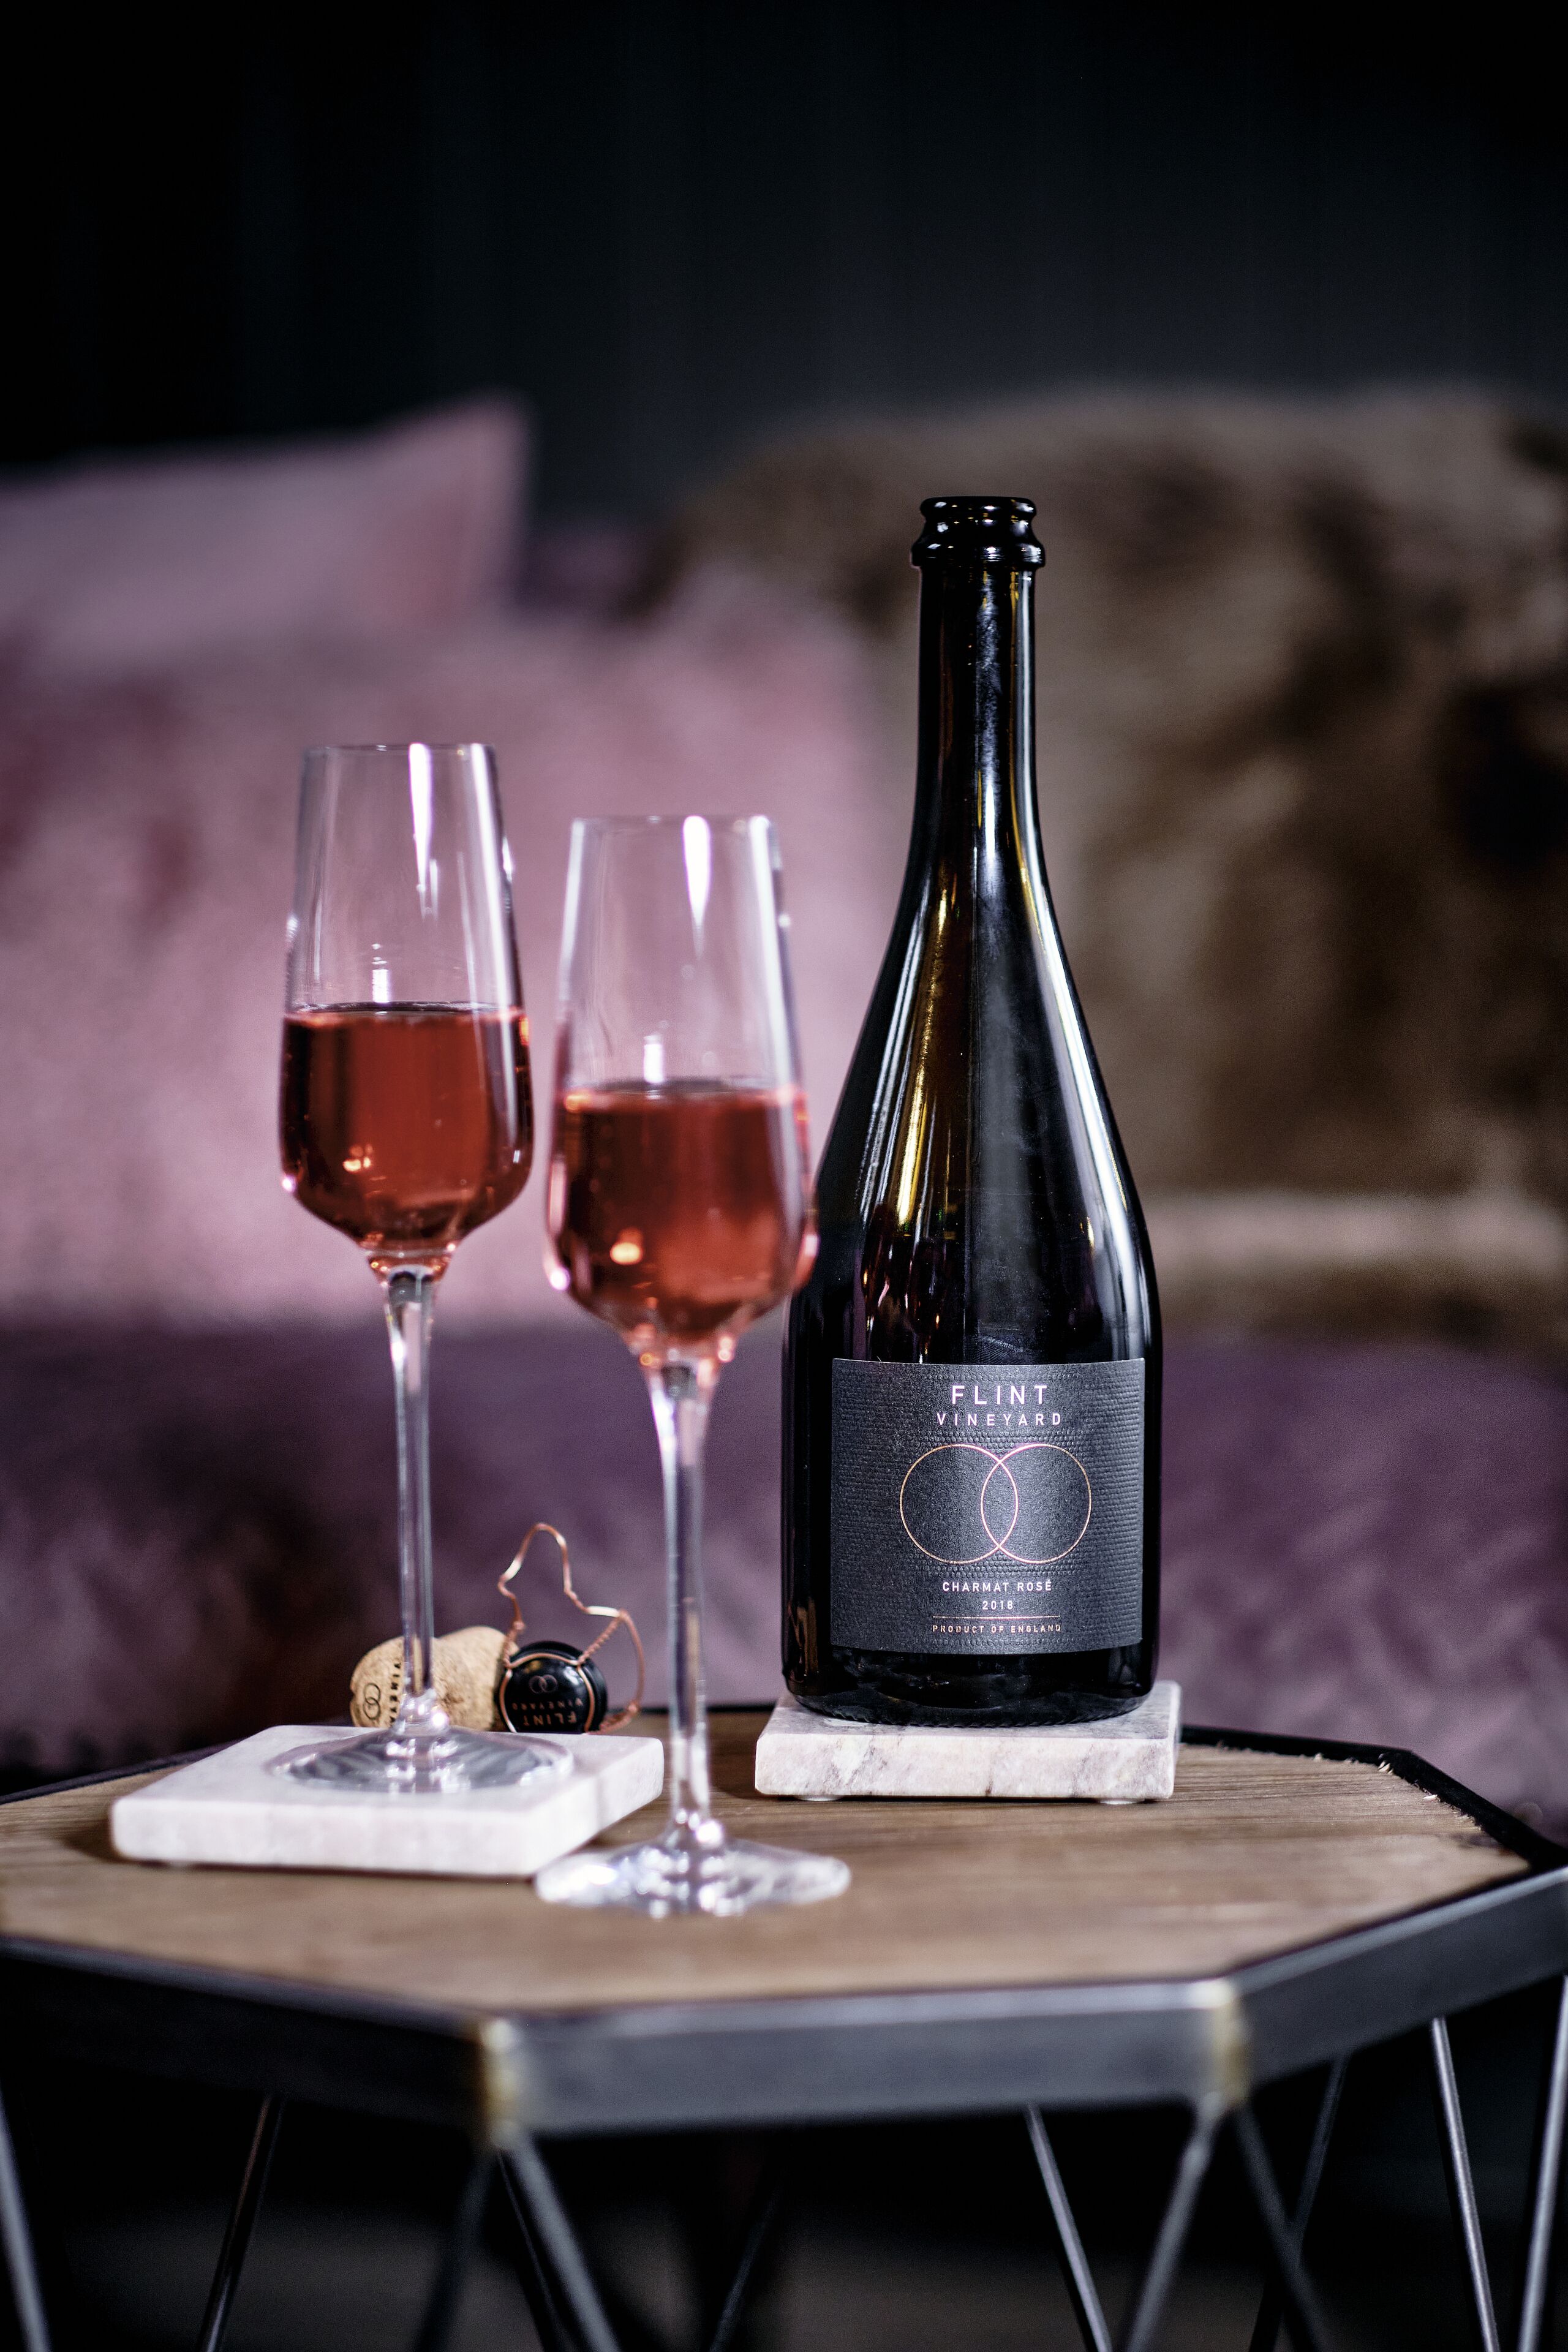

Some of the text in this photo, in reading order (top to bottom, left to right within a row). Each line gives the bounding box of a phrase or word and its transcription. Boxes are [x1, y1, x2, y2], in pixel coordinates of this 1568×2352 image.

[951, 1385, 1047, 1404] FLINT
[937, 1412, 1061, 1427] VINEYARD
[942, 1579, 1052, 1593] CHARMAT ROSÉ
[982, 1600, 1014, 1610] 2018
[932, 1625, 984, 1634] PRODUCT
[1011, 1624, 1061, 1634] ENGLAND
[390, 1661, 402, 1727] VINEYA
[511, 1697, 583, 1711] VINEYARD
[522, 1711, 577, 1726] FLINT
